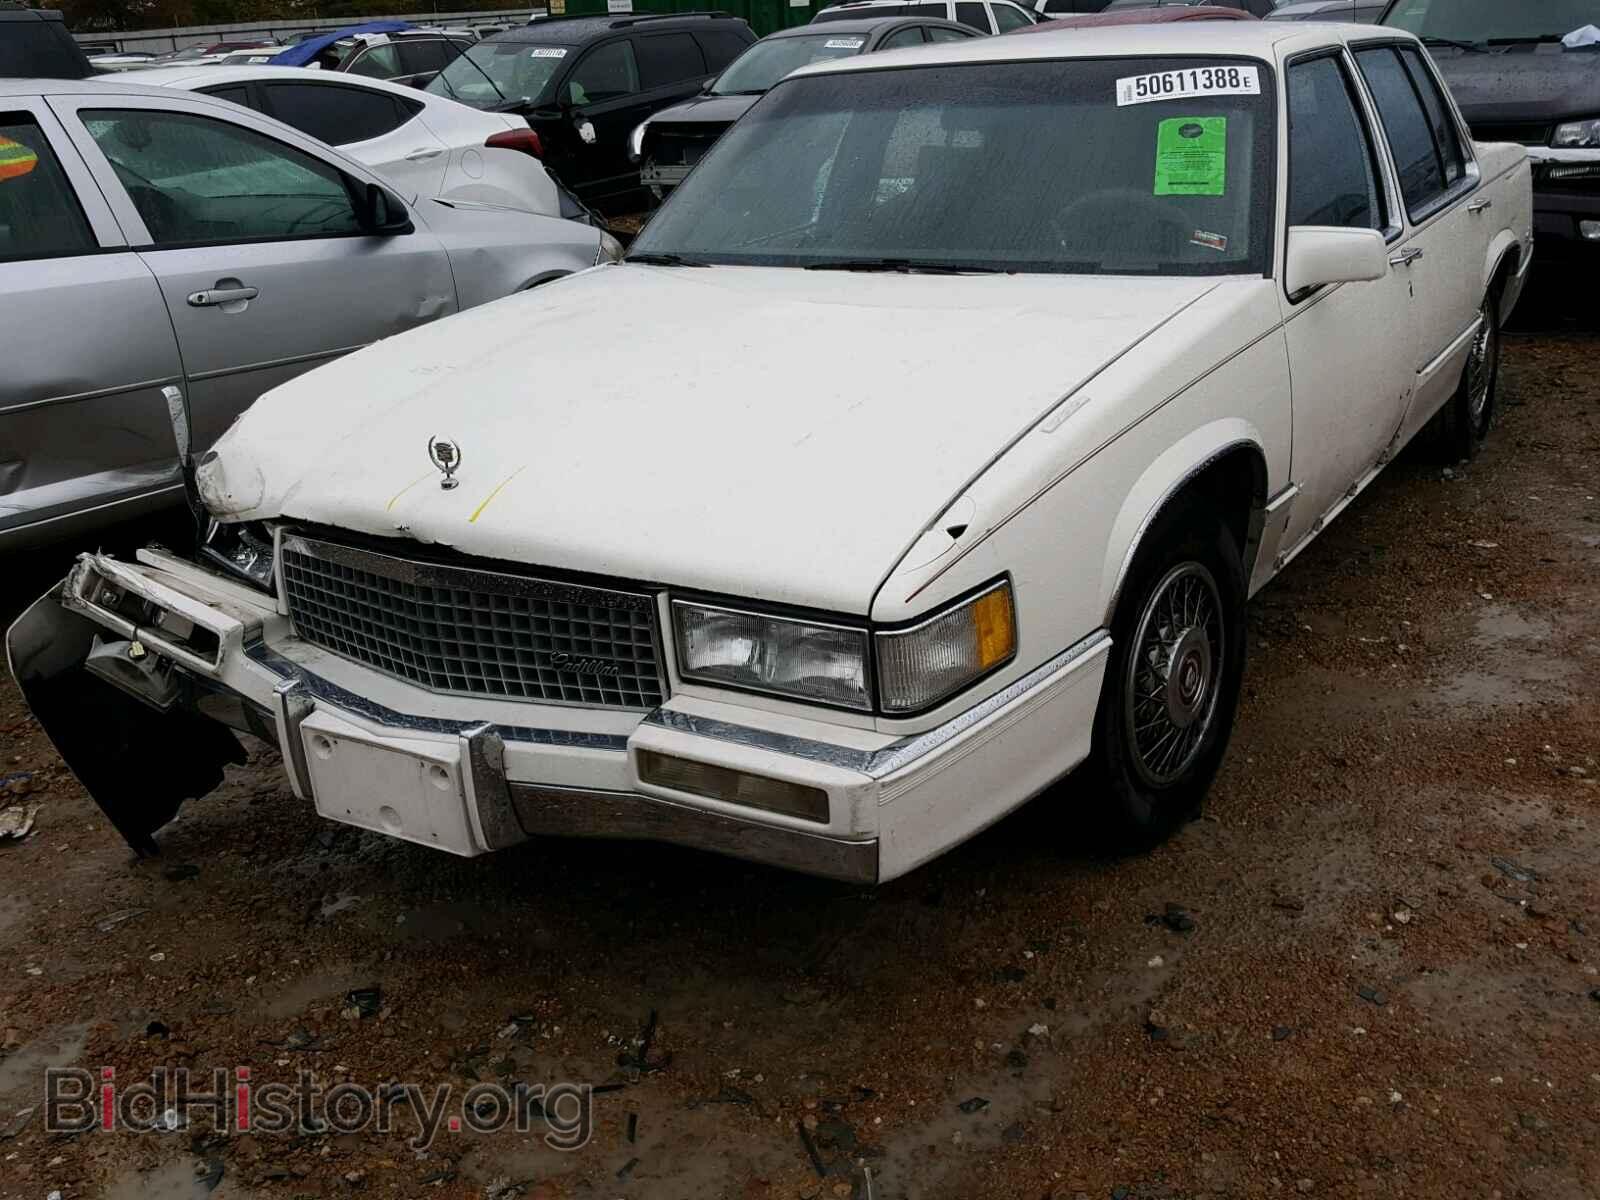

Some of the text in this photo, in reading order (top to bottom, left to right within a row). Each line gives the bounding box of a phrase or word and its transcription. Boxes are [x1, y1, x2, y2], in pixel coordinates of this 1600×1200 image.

[1135, 68, 1240, 97] 50611388
[1243, 76, 1252, 88] E
[550, 650, 619, 678] Cadillac
